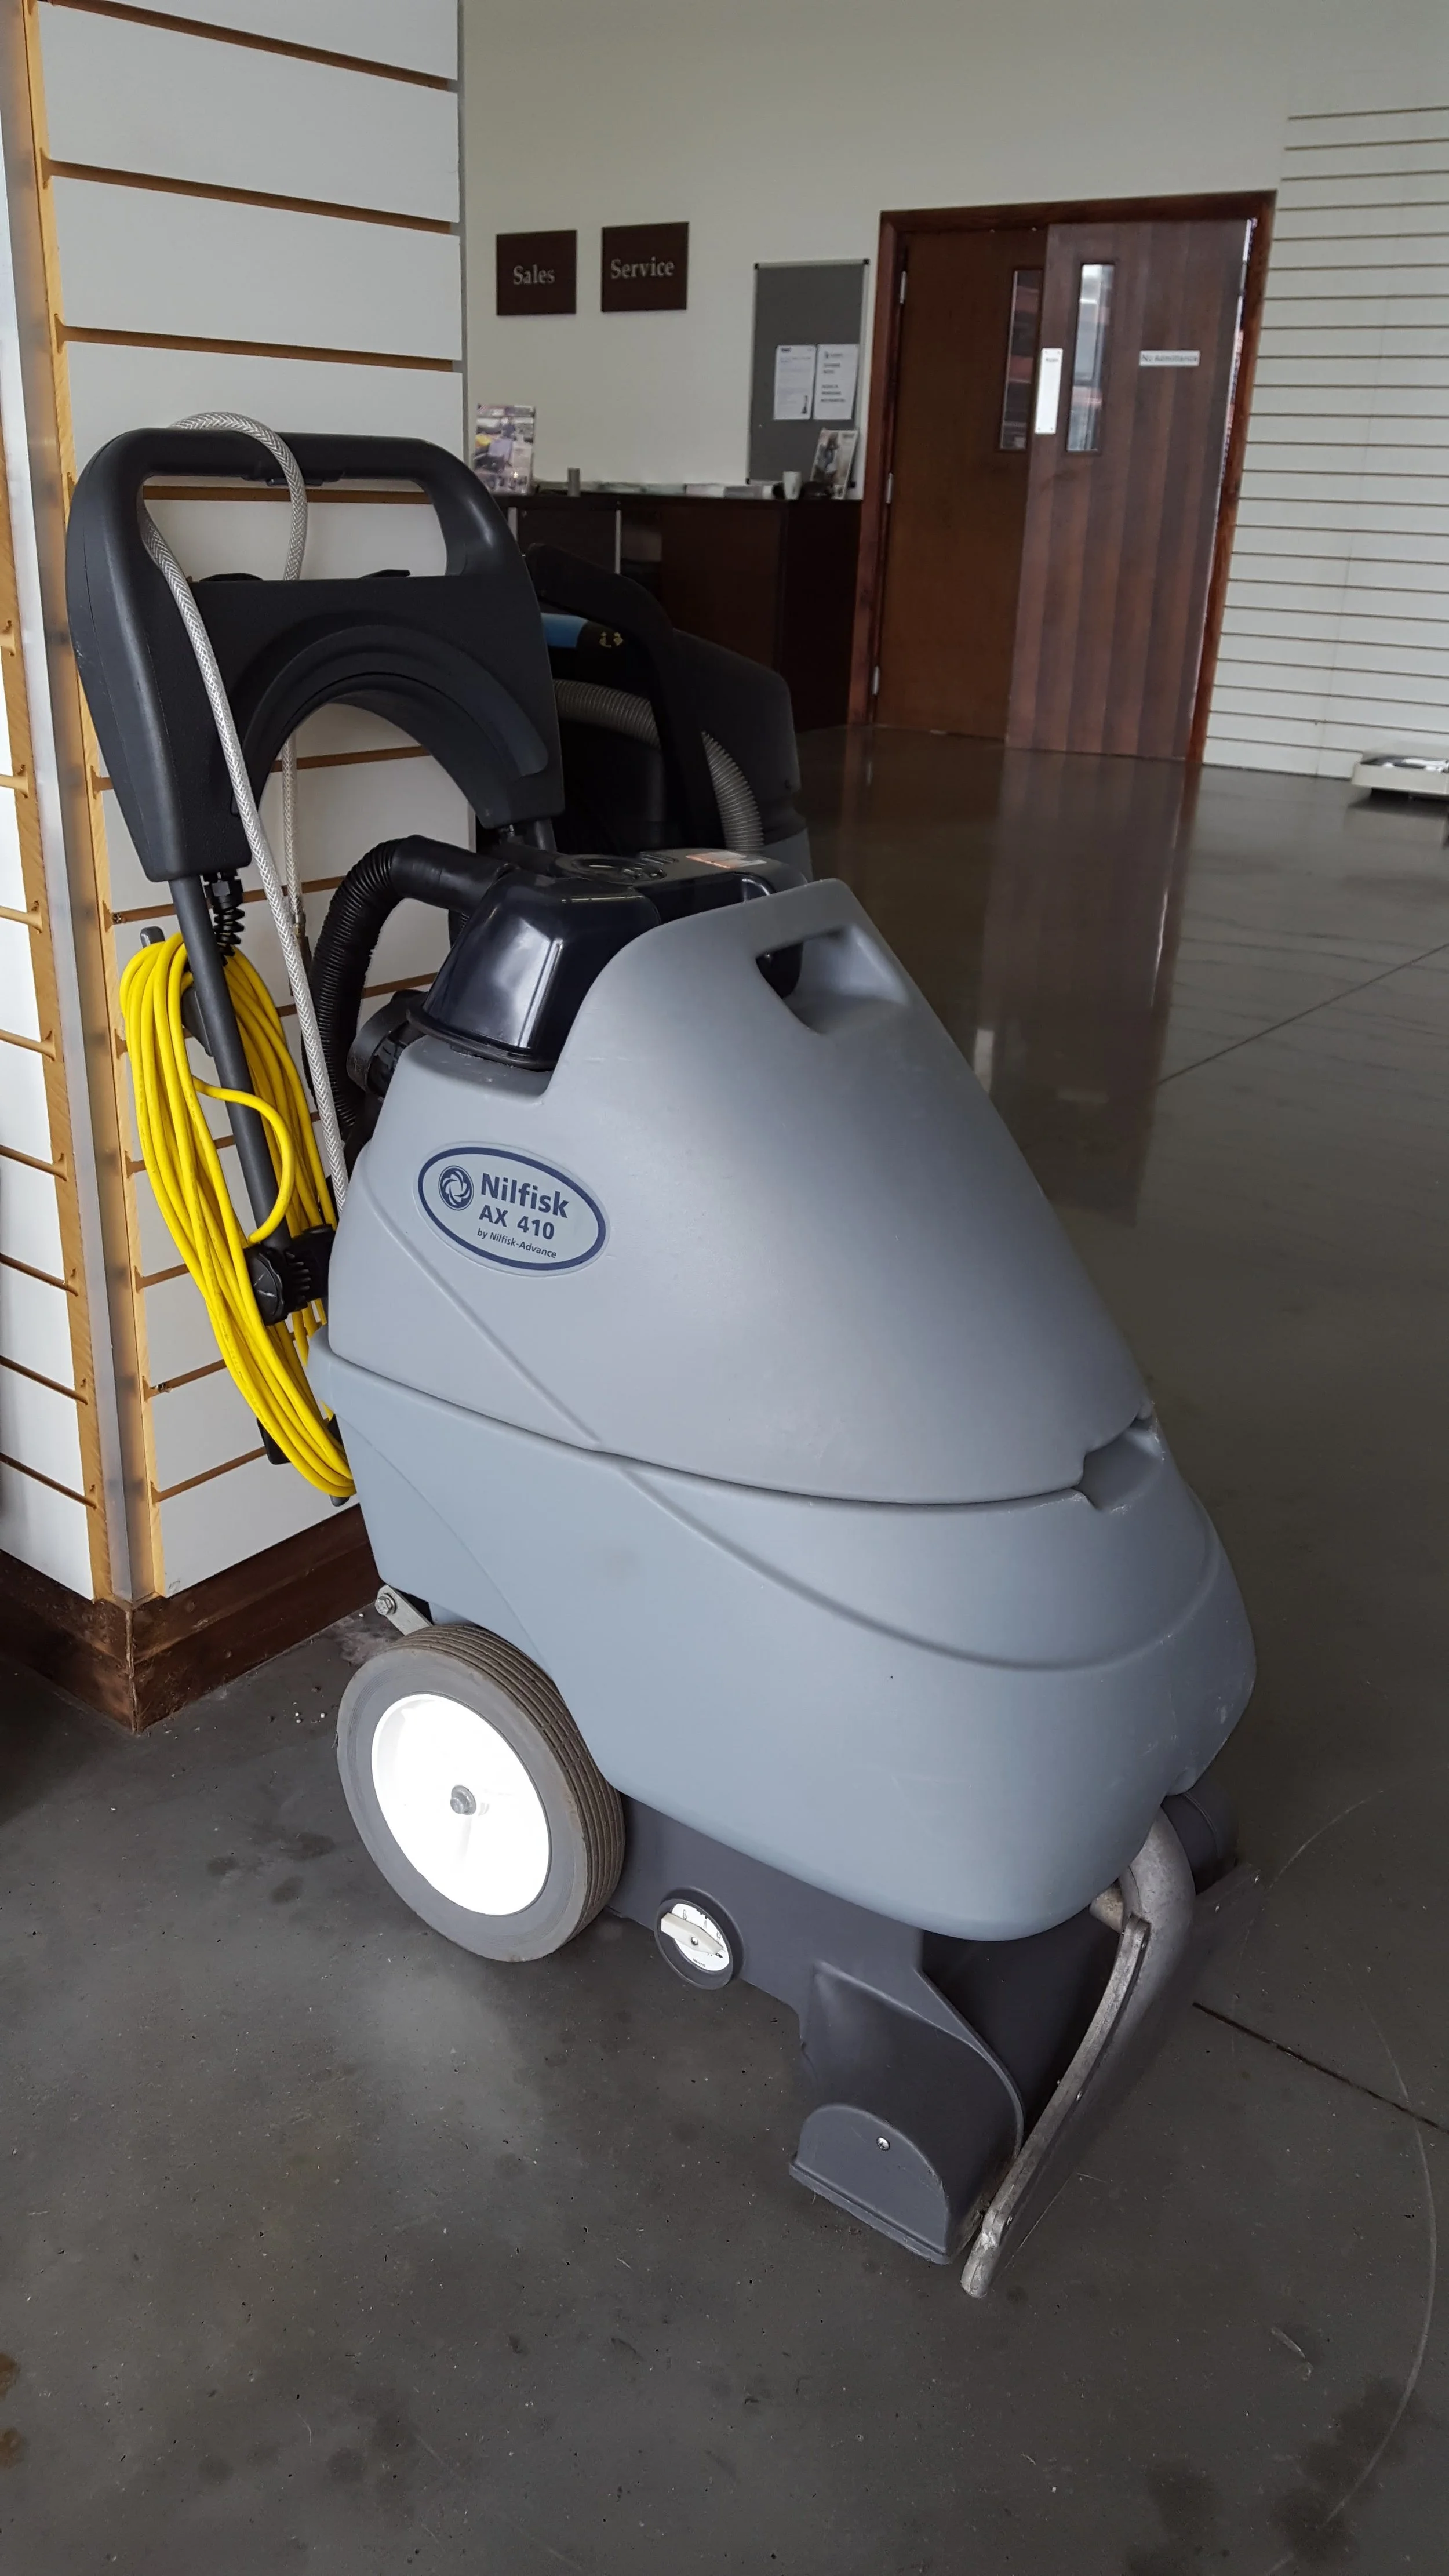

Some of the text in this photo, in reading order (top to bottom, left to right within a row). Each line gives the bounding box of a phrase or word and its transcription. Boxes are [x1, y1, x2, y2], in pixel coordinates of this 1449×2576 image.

[513, 264, 555, 285] Sales
[610, 256, 675, 279] Service
[480, 1172, 569, 1218] Nilfisk
[479, 1204, 555, 1240] AX 410
[477, 1228, 557, 1258] by Nilfisk-Advance
